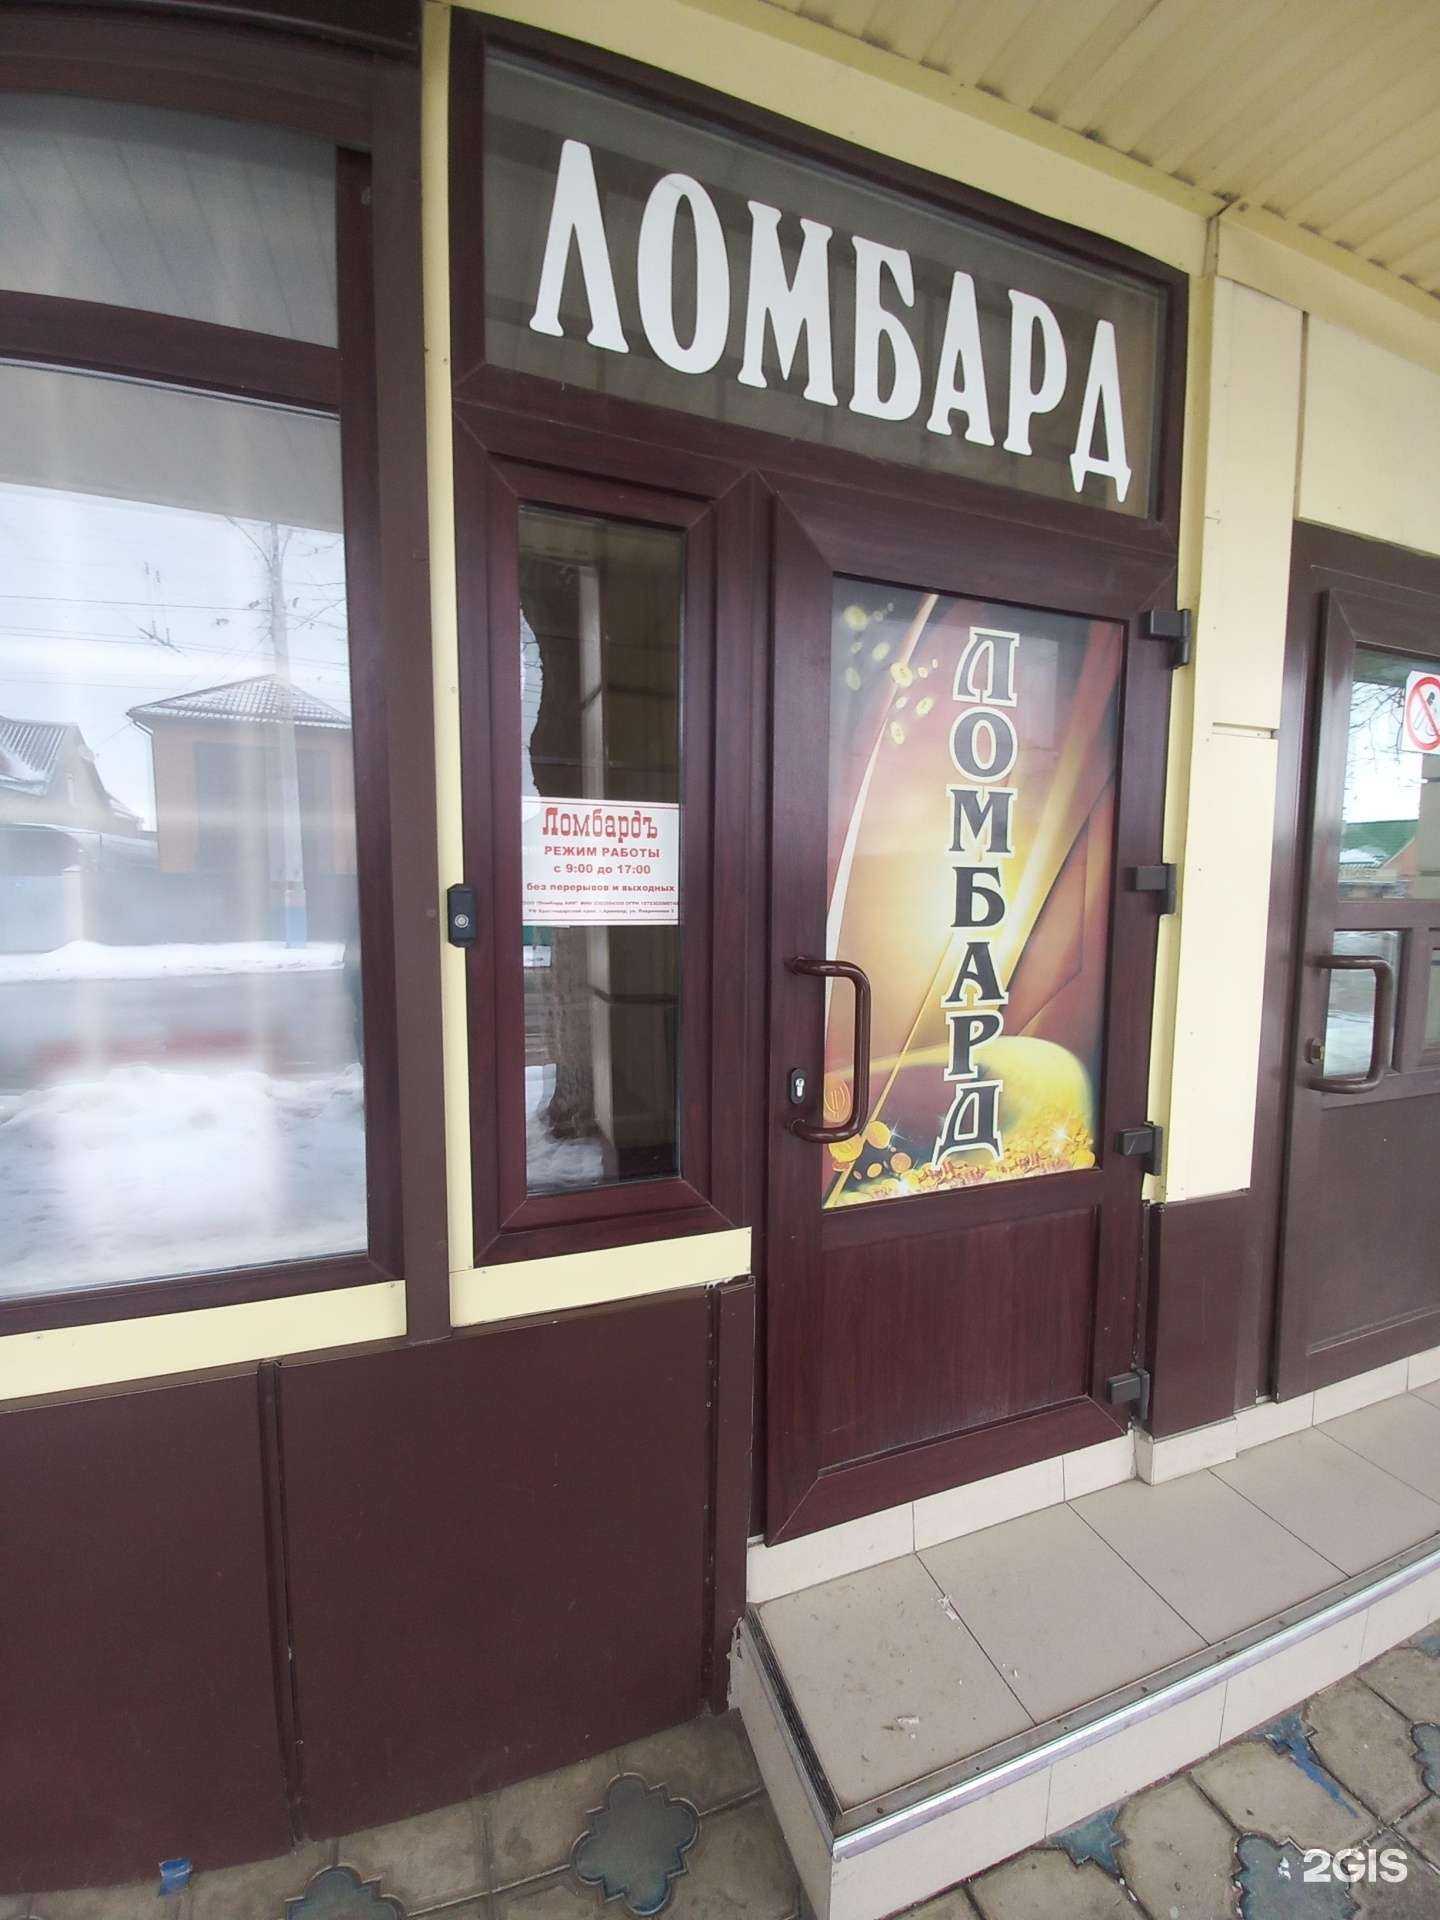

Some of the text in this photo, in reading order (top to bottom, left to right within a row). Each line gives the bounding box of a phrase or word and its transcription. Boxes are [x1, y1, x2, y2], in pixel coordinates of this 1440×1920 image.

[529, 139, 1132, 503] ЛОМБАРД
[542, 807, 658, 843] Ломбардъ
[544, 846, 661, 858] РЕЖИМ РАБОТЫ
[566, 863, 593, 873] 9:00
[597, 866, 613, 875] до
[617, 864, 651, 874] 17:00
[526, 882, 546, 891] без
[550, 884, 609, 893] перерывов
[622, 885, 676, 893] выходных
[932, 627, 1020, 1169] ЛОМБАРД
